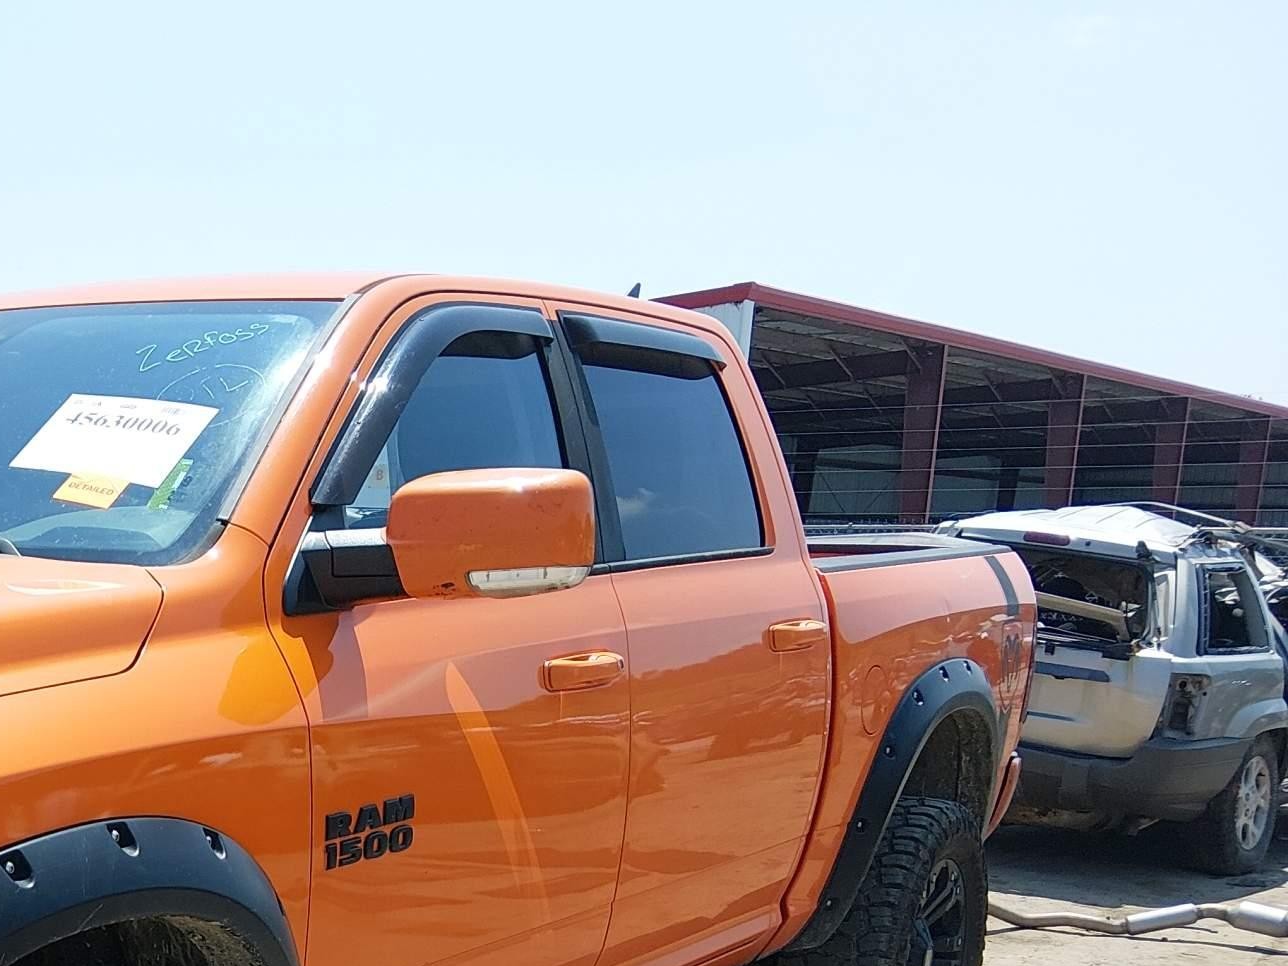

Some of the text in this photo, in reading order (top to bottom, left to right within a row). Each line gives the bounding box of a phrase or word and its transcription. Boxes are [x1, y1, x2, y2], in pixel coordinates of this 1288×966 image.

[66, 411, 181, 436] 45630006
[68, 481, 114, 496] DETAILED
[325, 793, 415, 842] RAM
[325, 824, 414, 871] 1500
